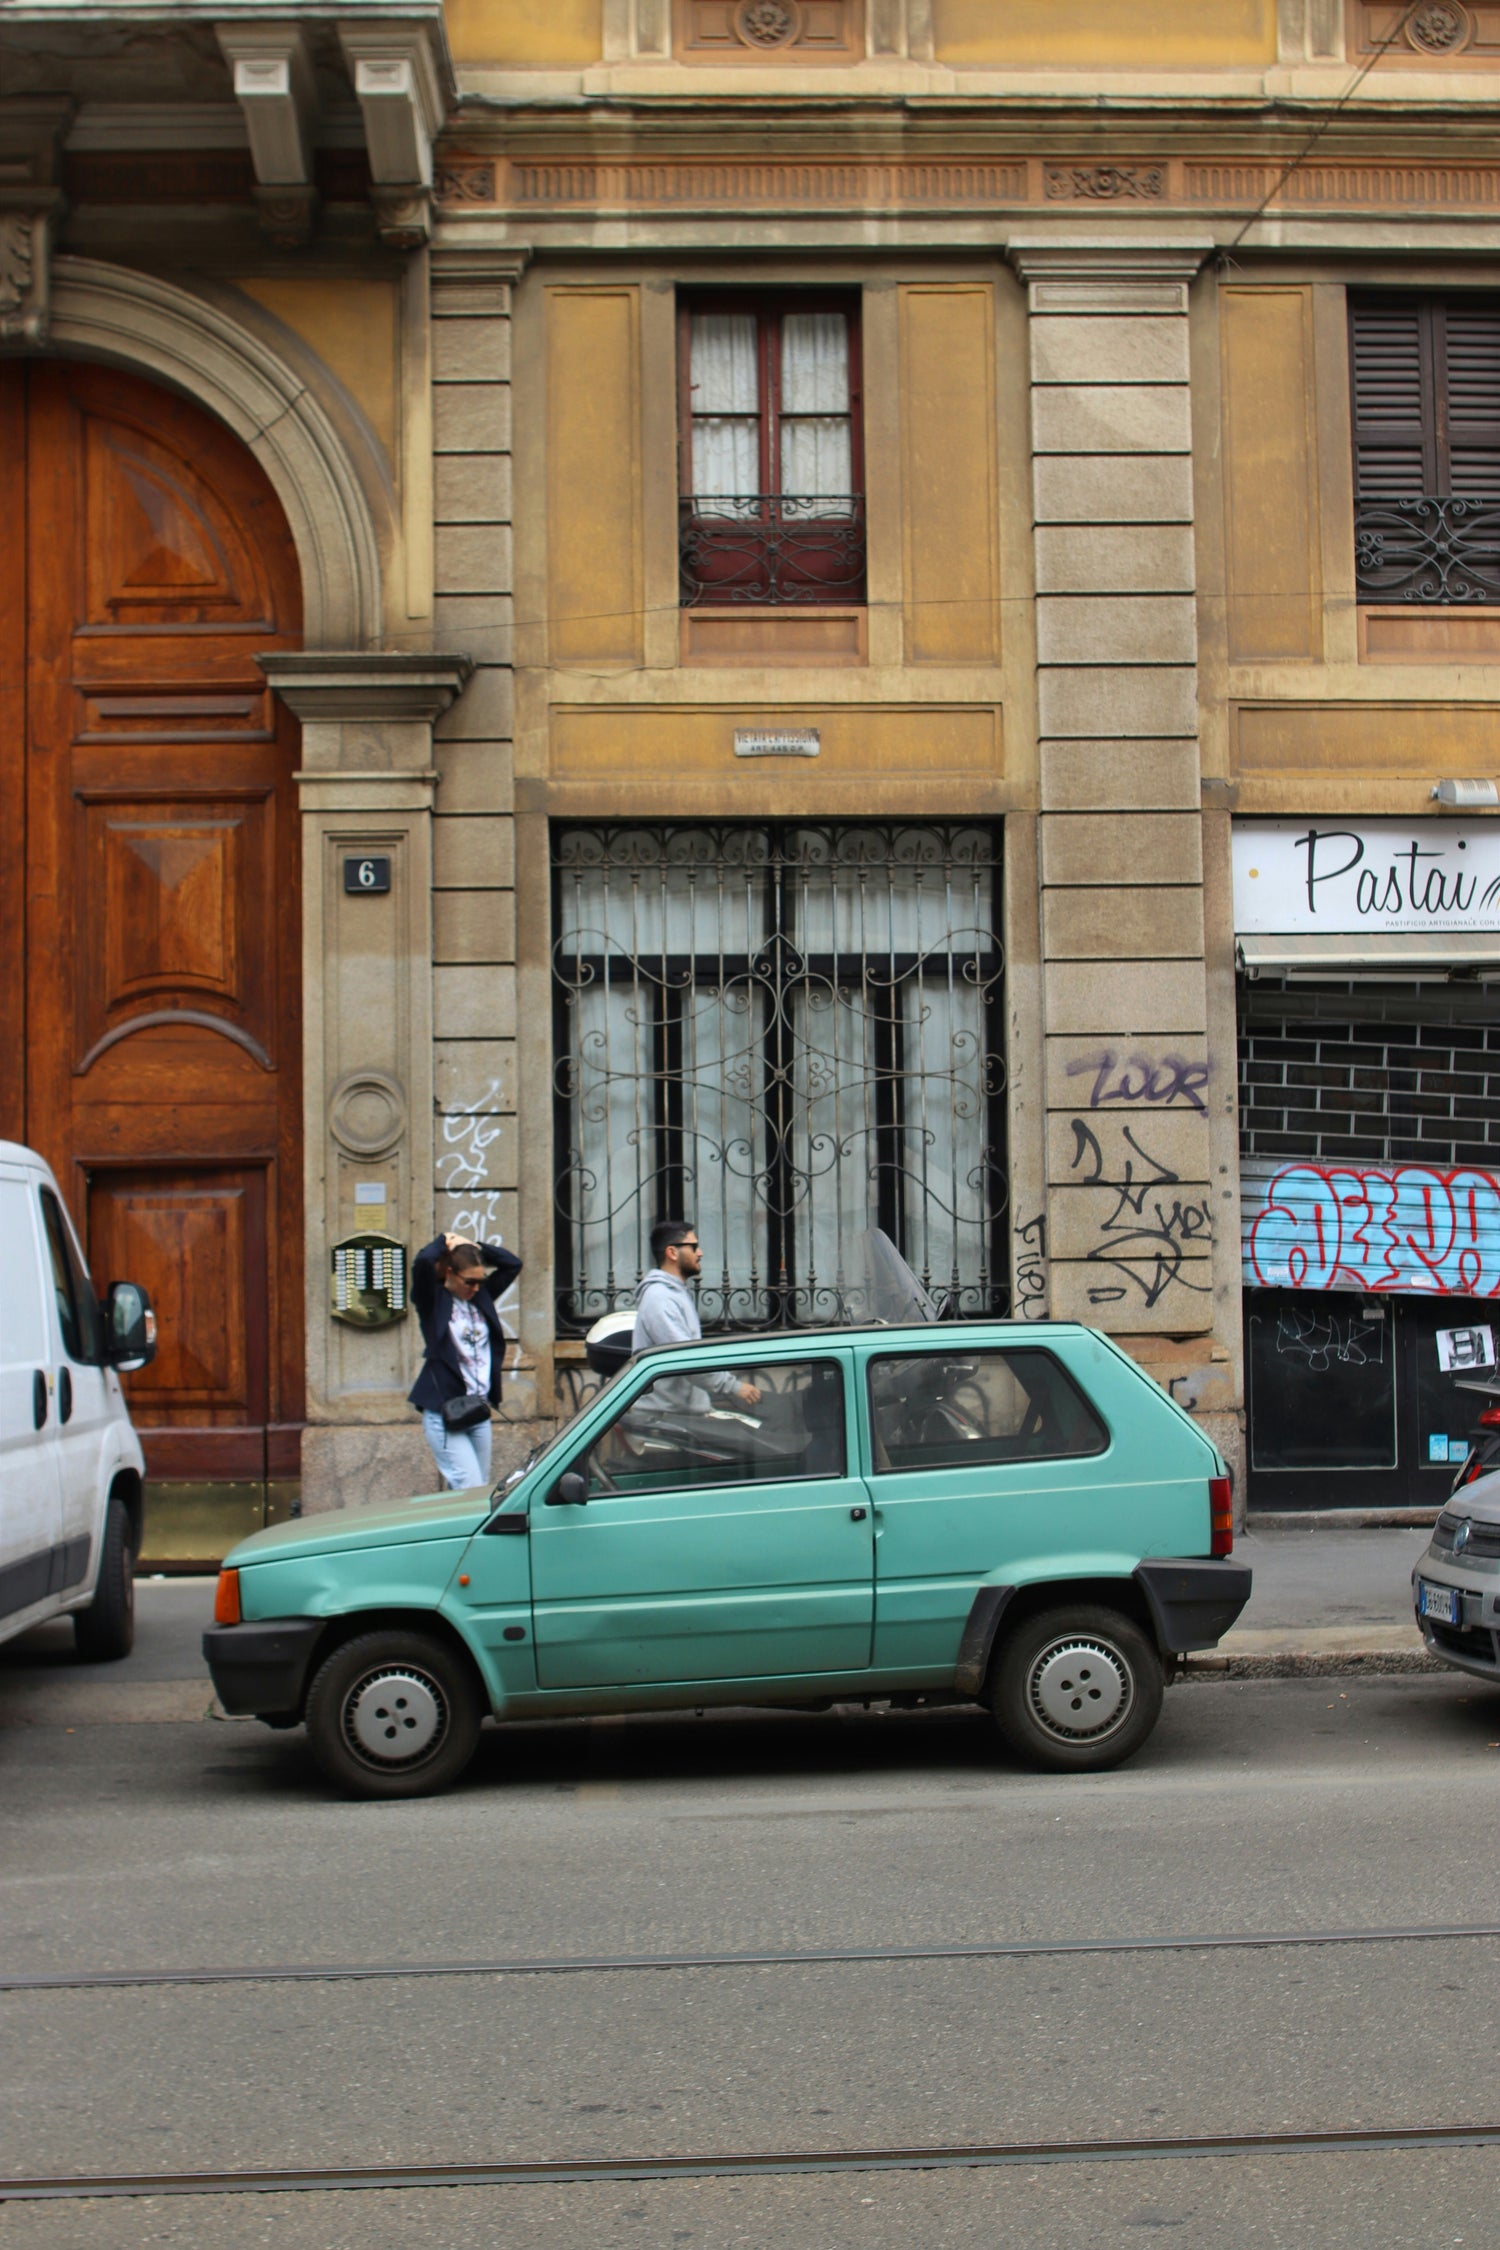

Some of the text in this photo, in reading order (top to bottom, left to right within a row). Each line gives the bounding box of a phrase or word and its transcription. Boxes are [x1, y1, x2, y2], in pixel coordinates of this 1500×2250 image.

[359, 861, 375, 886] 6
[1385, 919, 1426, 928] PASTIFICIO
[1428, 919, 1477, 927] ARTIGIANALE
